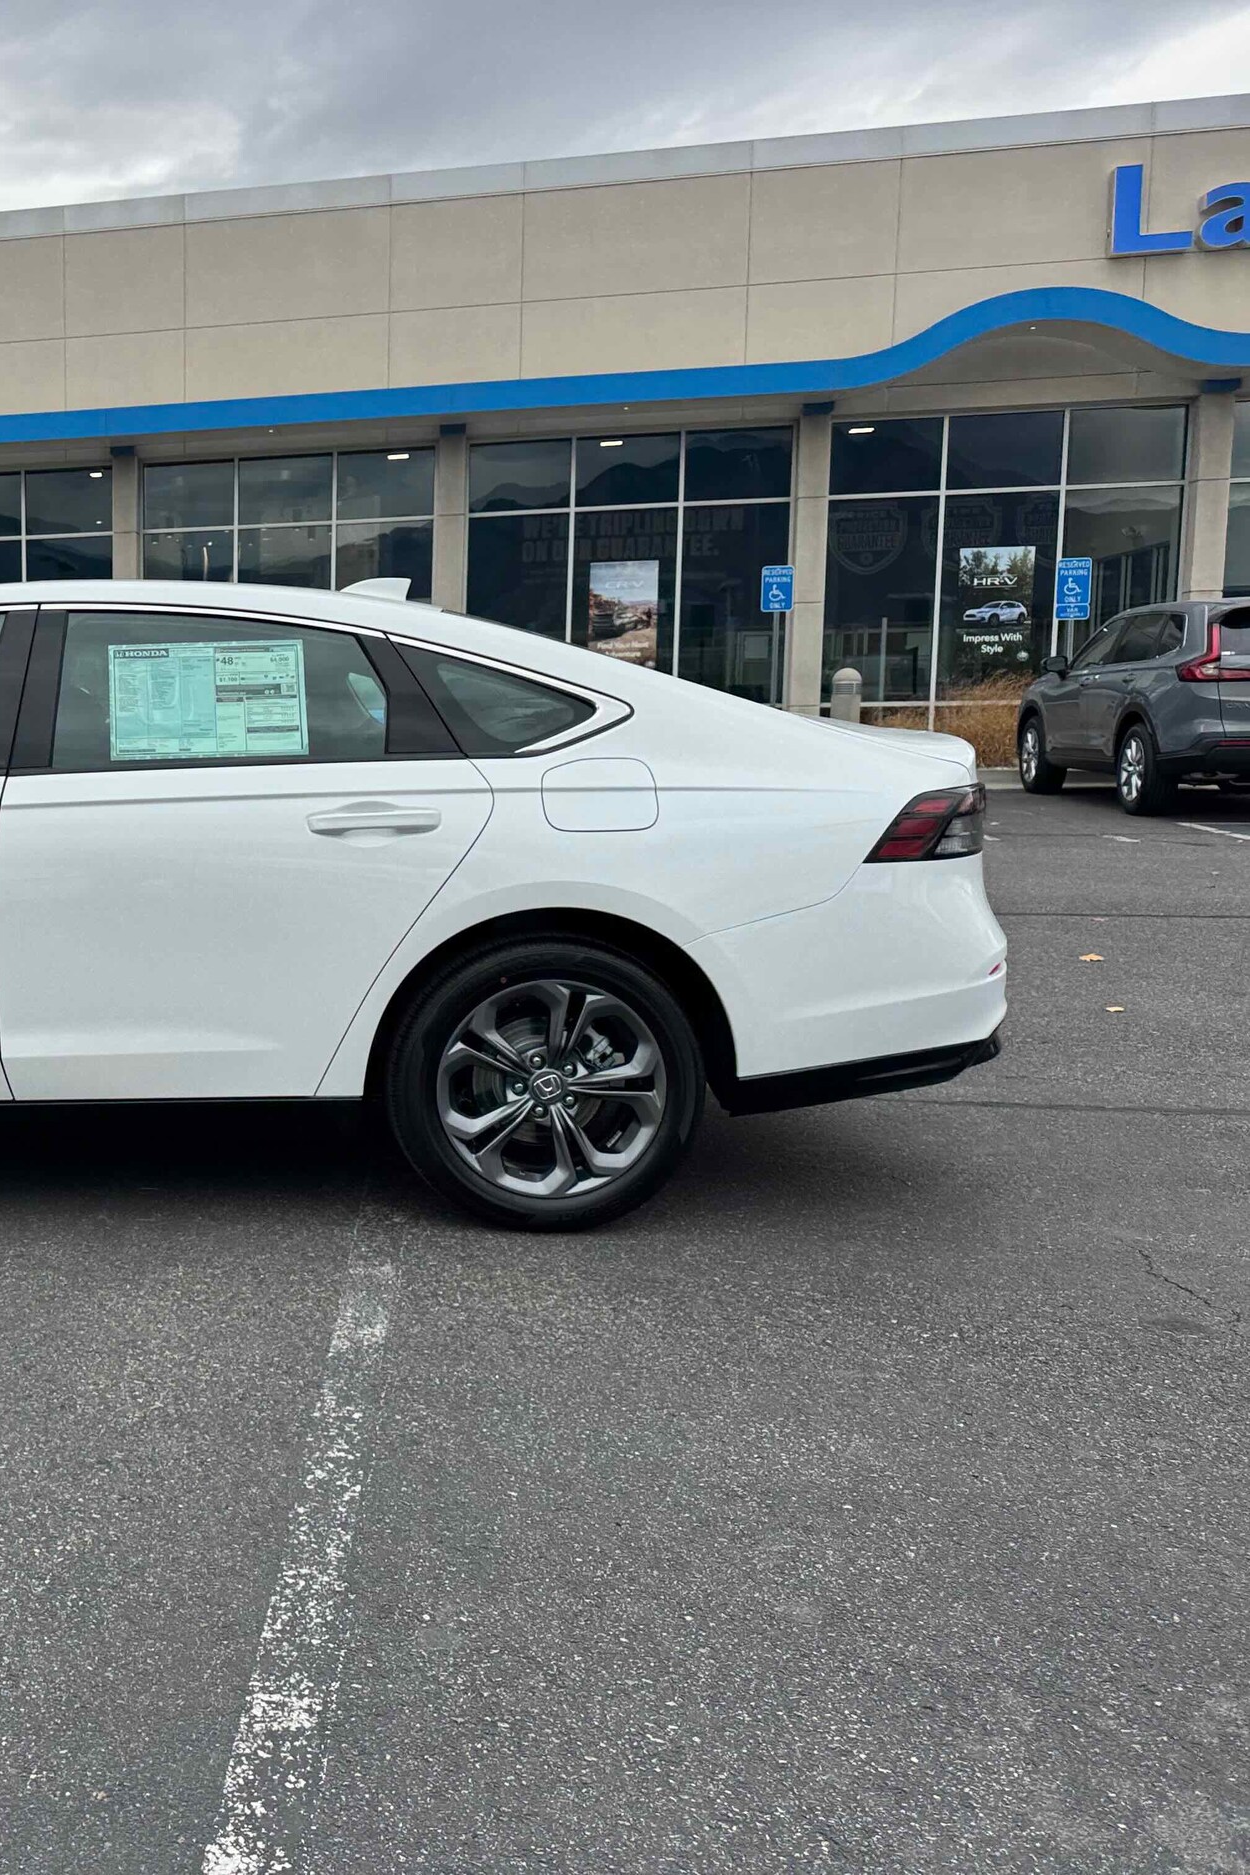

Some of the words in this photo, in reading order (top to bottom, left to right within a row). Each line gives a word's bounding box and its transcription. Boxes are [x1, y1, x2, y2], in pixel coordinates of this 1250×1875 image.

[973, 577, 1018, 586] HR-V
[963, 633, 999, 644] Impress
[1000, 631, 1023, 642] With
[125, 650, 168, 658] HONDA
[980, 644, 1004, 655] Style
[220, 656, 234, 666] 48
